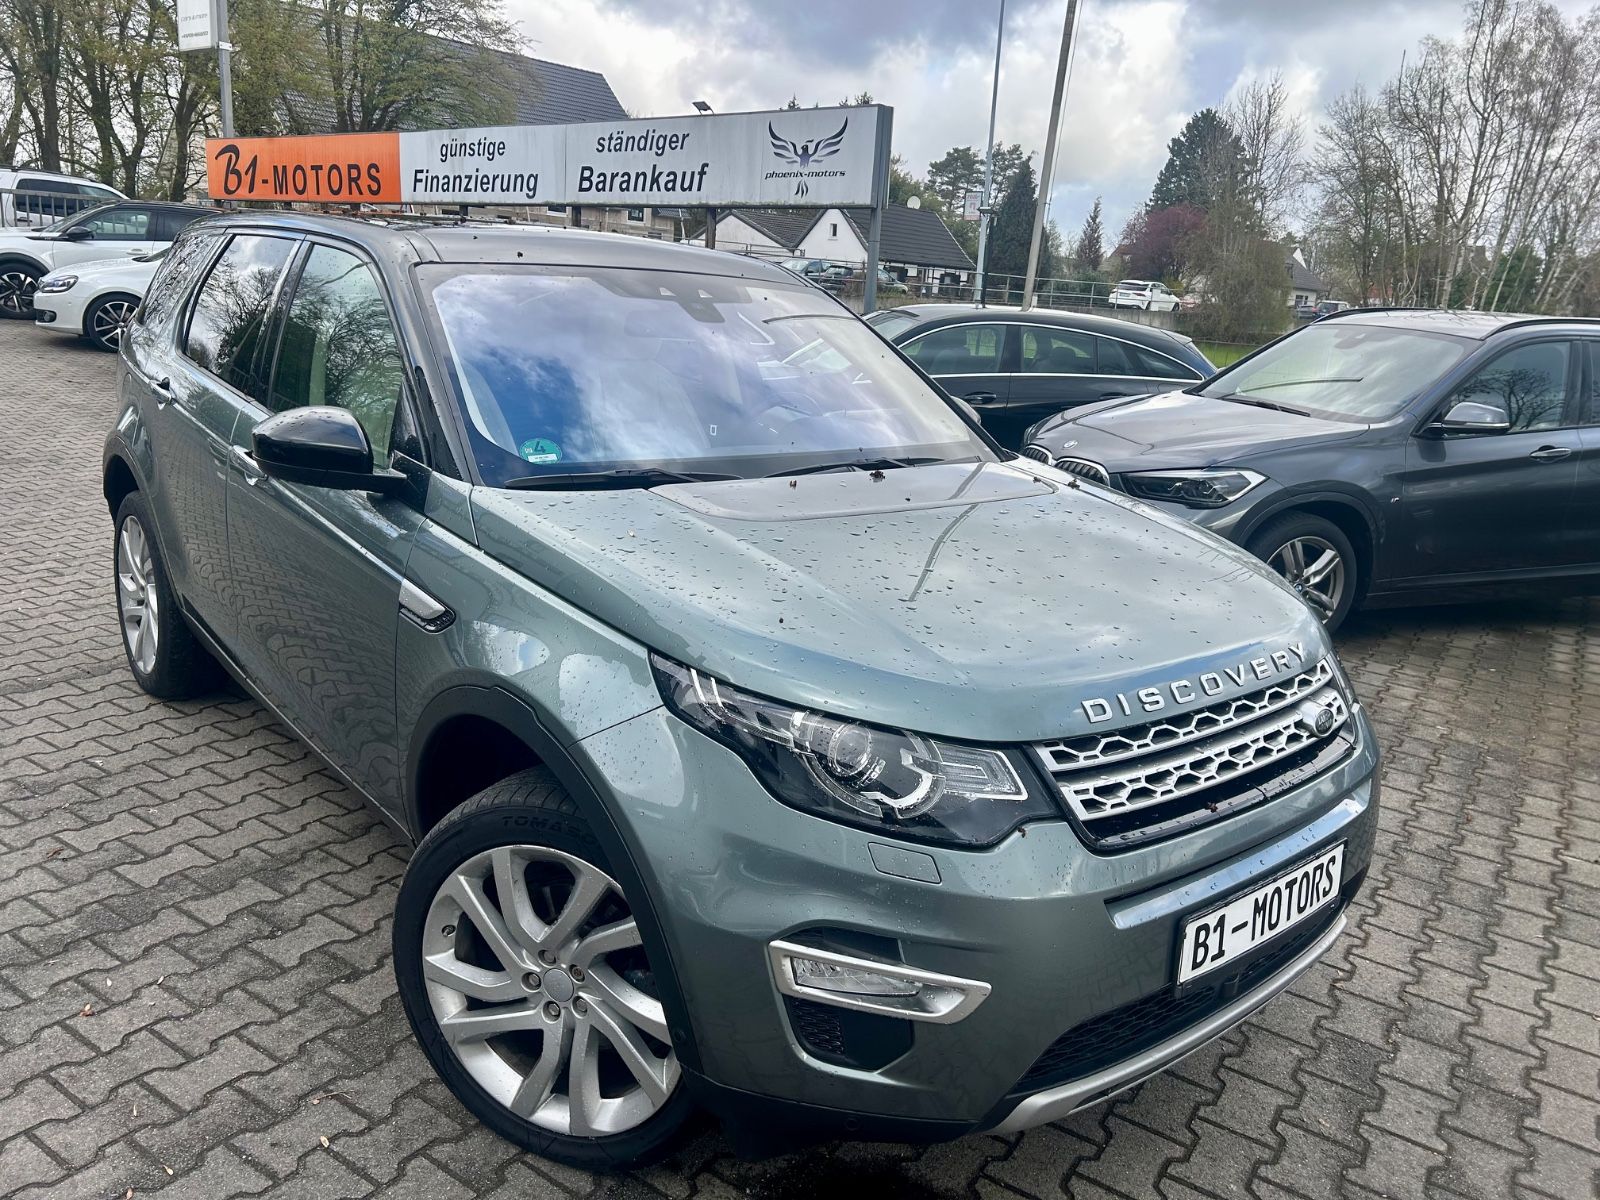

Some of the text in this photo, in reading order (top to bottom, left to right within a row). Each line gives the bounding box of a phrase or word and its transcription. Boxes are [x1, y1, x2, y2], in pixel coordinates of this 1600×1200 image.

[439, 137, 506, 163] günstige
[595, 129, 691, 156] ständiger
[214, 143, 383, 197] B1-MOTORS
[412, 168, 539, 200] Finanzierung
[577, 162, 709, 193] Barankauf
[764, 170, 847, 180] phoenix-motors
[534, 440, 546, 453] 4
[1081, 642, 1305, 723] DISCOVERY
[1191, 854, 1337, 971] B1-MOTORS
